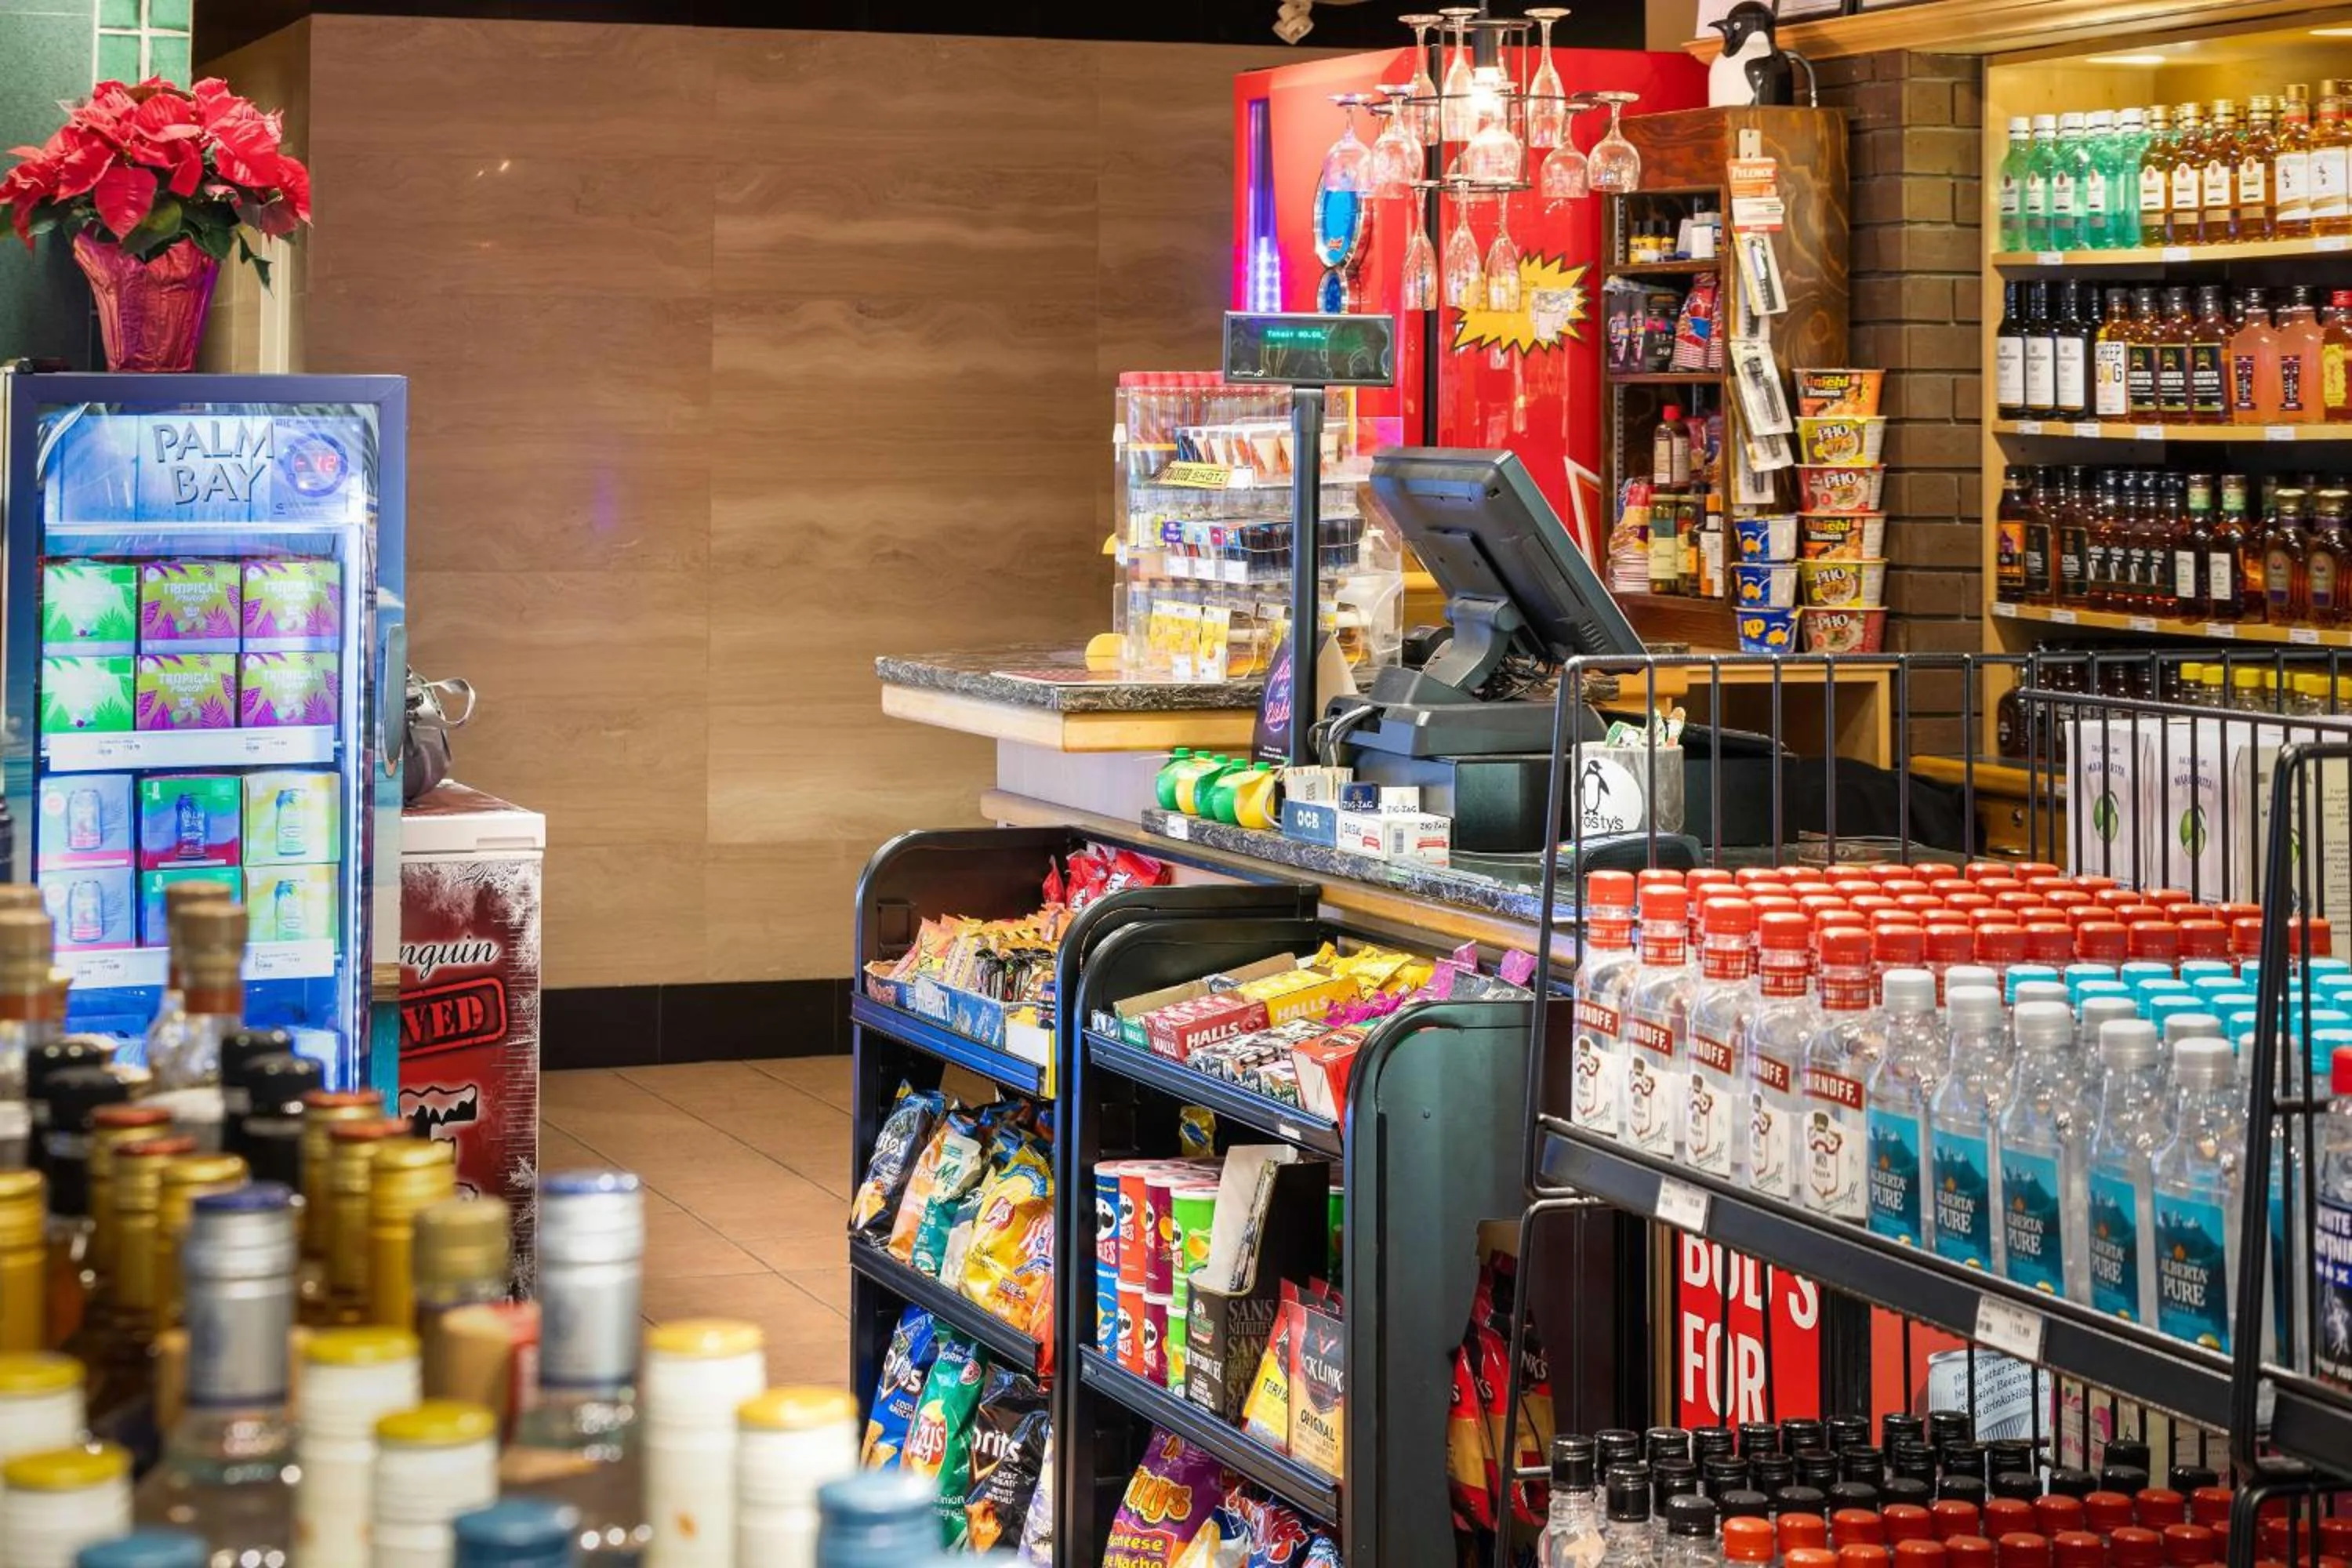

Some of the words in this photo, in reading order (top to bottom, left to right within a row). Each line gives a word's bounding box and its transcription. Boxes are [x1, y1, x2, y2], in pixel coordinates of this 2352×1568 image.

[152, 420, 276, 463] PALM
[171, 463, 267, 506] BAY
[2088, 761, 2126, 779] MARRITA
[1297, 810, 1319, 829] OCB
[1277, 996, 1329, 1020] HALLS
[1185, 1022, 1241, 1048] HALLS
[1871, 1183, 1904, 1211] PURE
[1938, 1204, 1972, 1235] PURE
[2008, 1227, 2042, 1255] PURE
[1683, 1233, 1819, 1330] BUDS
[2092, 1254, 2122, 1284] PURE
[2160, 1257, 2209, 1284] ALBERTA
[2163, 1275, 2206, 1306] PURE
[1228, 1298, 1274, 1322] SANS
[1683, 1310, 1767, 1426] FOR
